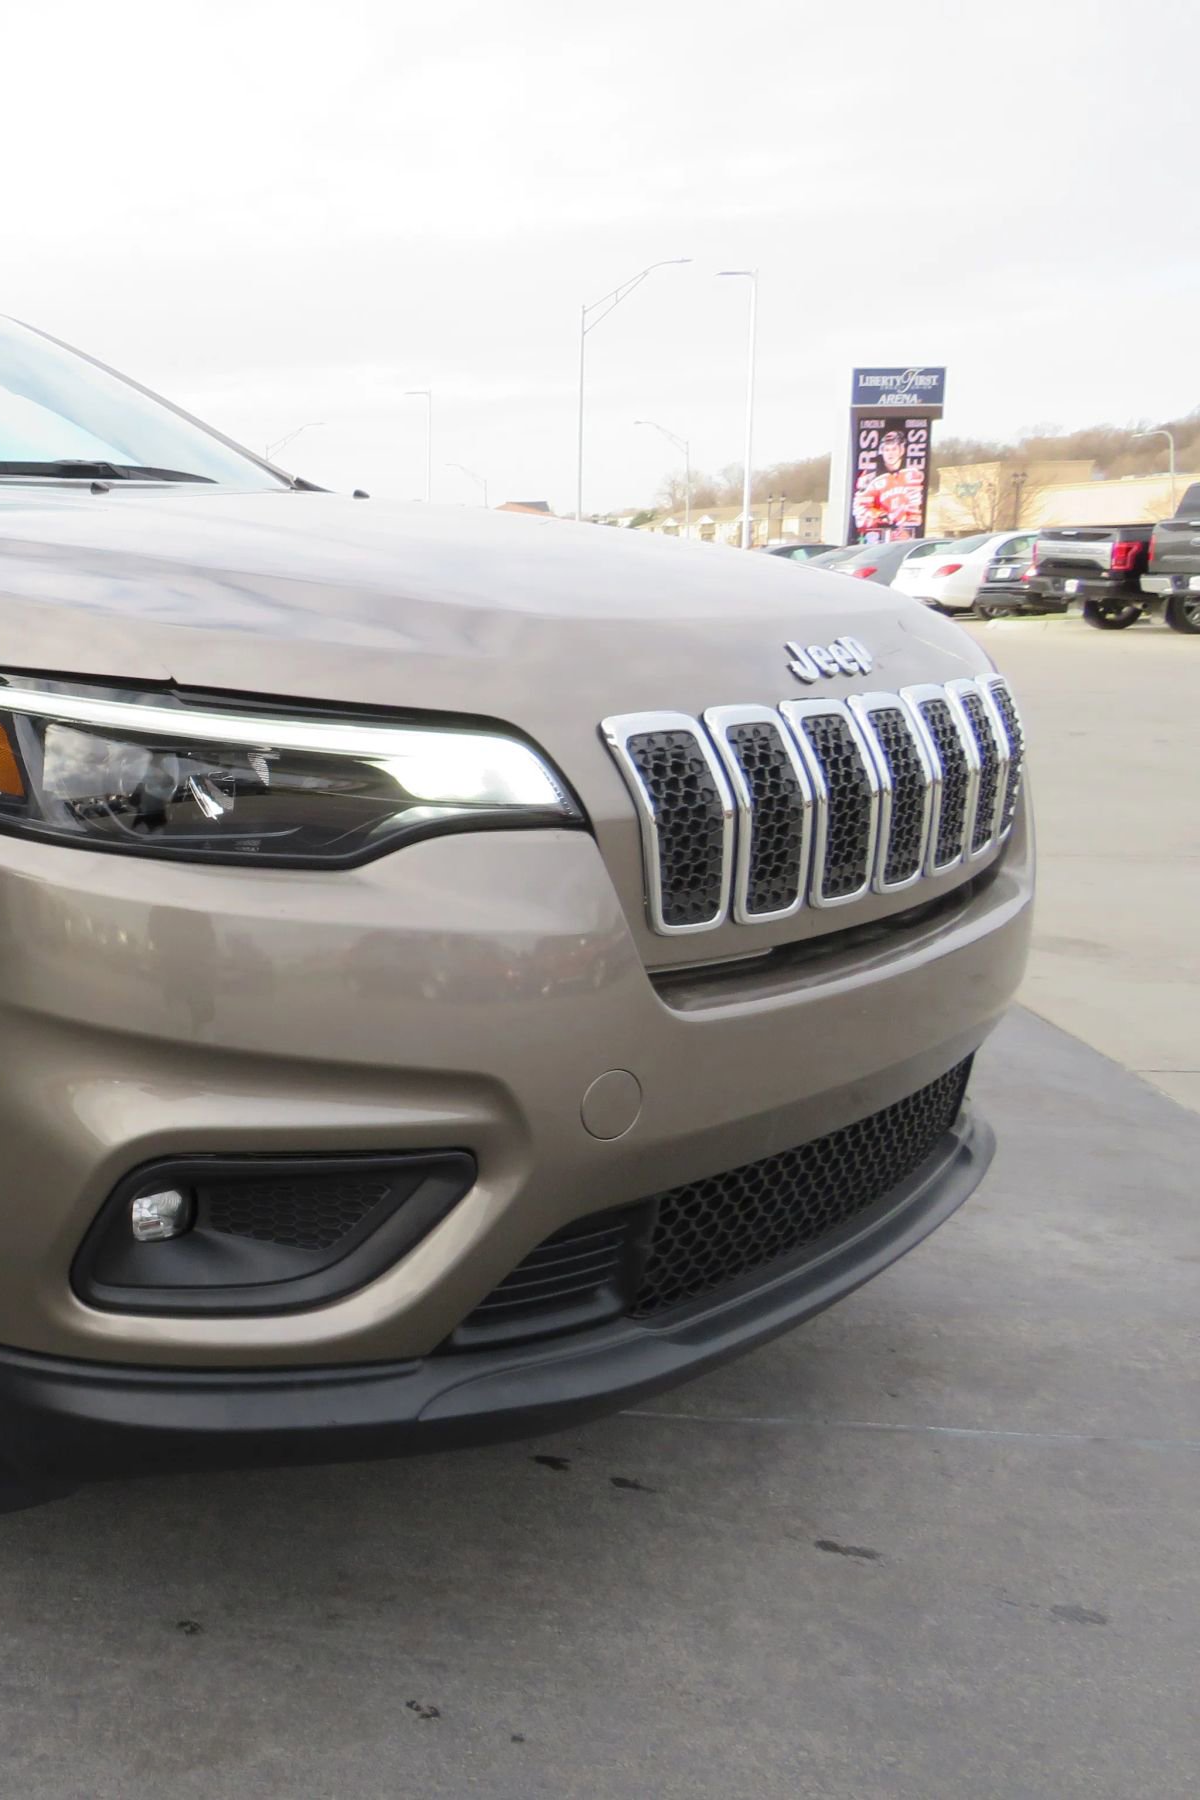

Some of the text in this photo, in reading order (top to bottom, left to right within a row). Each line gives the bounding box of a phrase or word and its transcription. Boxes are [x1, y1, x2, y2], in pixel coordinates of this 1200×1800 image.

[859, 368, 939, 393] LIBERTY FIRST
[877, 394, 919, 405] ARENA
[784, 636, 872, 685] Jeep
